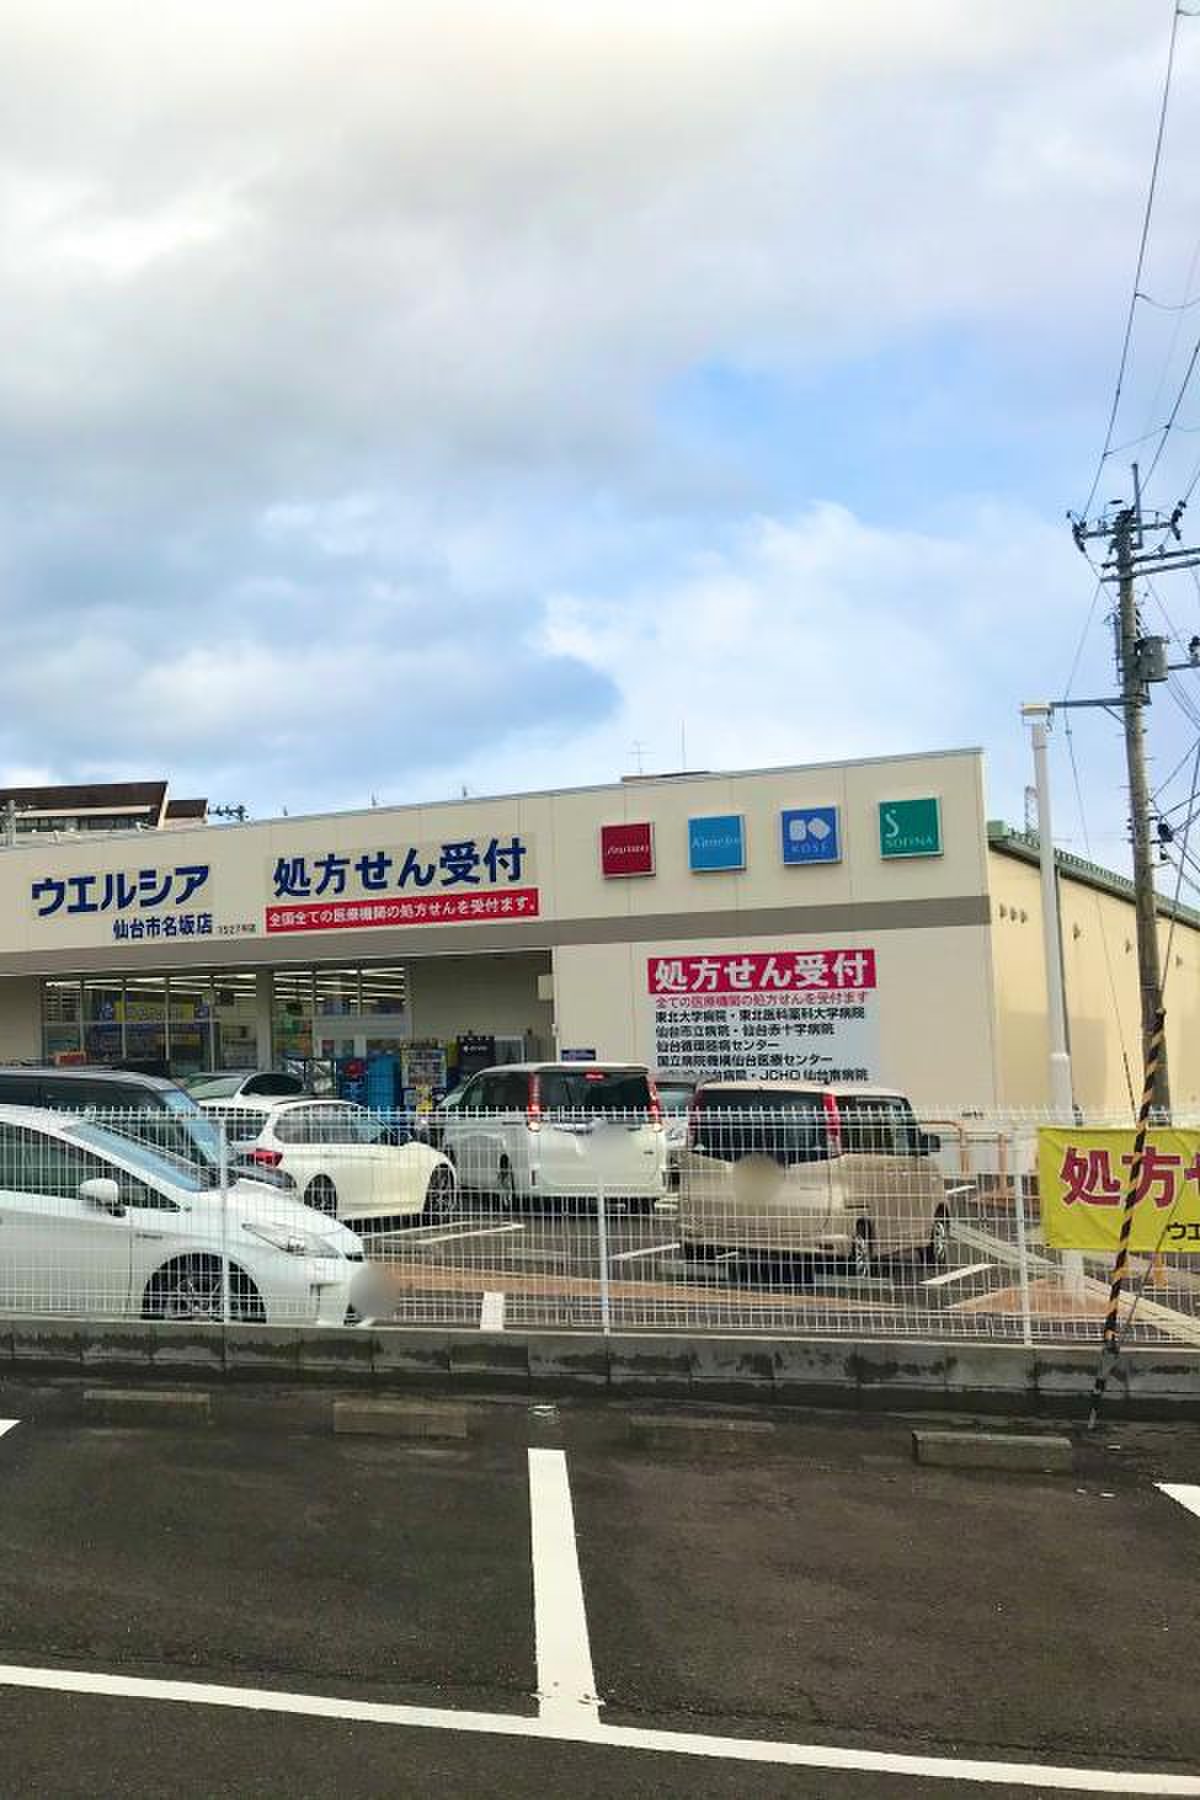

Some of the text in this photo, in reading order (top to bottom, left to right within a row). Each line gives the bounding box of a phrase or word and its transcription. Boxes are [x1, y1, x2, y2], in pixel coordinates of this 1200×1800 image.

[31, 864, 210, 917] ウエルシア
[273, 837, 527, 897] 処方せん受付
[113, 912, 213, 940] 仙台市名坂店
[655, 952, 869, 992] 処方せん受付
[1060, 1146, 1200, 1209] 処方
